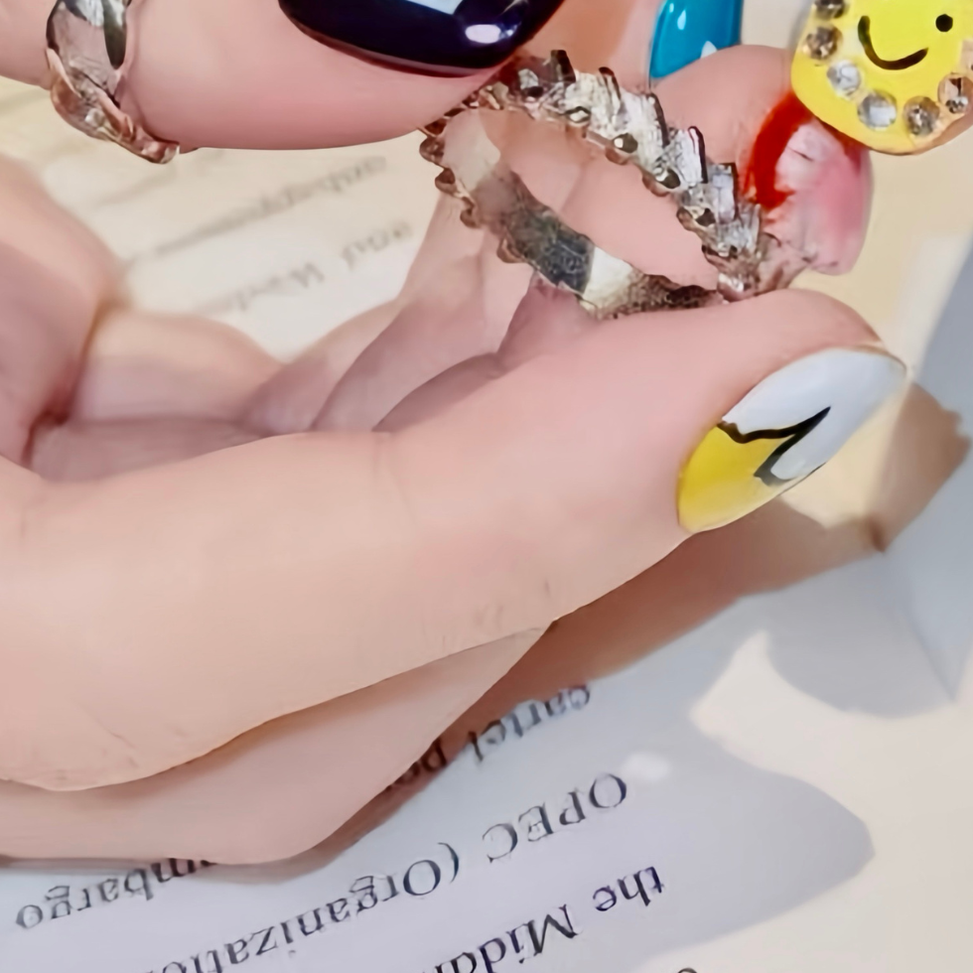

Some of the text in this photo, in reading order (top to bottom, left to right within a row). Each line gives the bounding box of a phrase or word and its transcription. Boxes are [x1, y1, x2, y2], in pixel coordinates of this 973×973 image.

[482, 773, 627, 864] OPEC
[16, 858, 217, 929] mbargo
[593, 866, 664, 912] the
